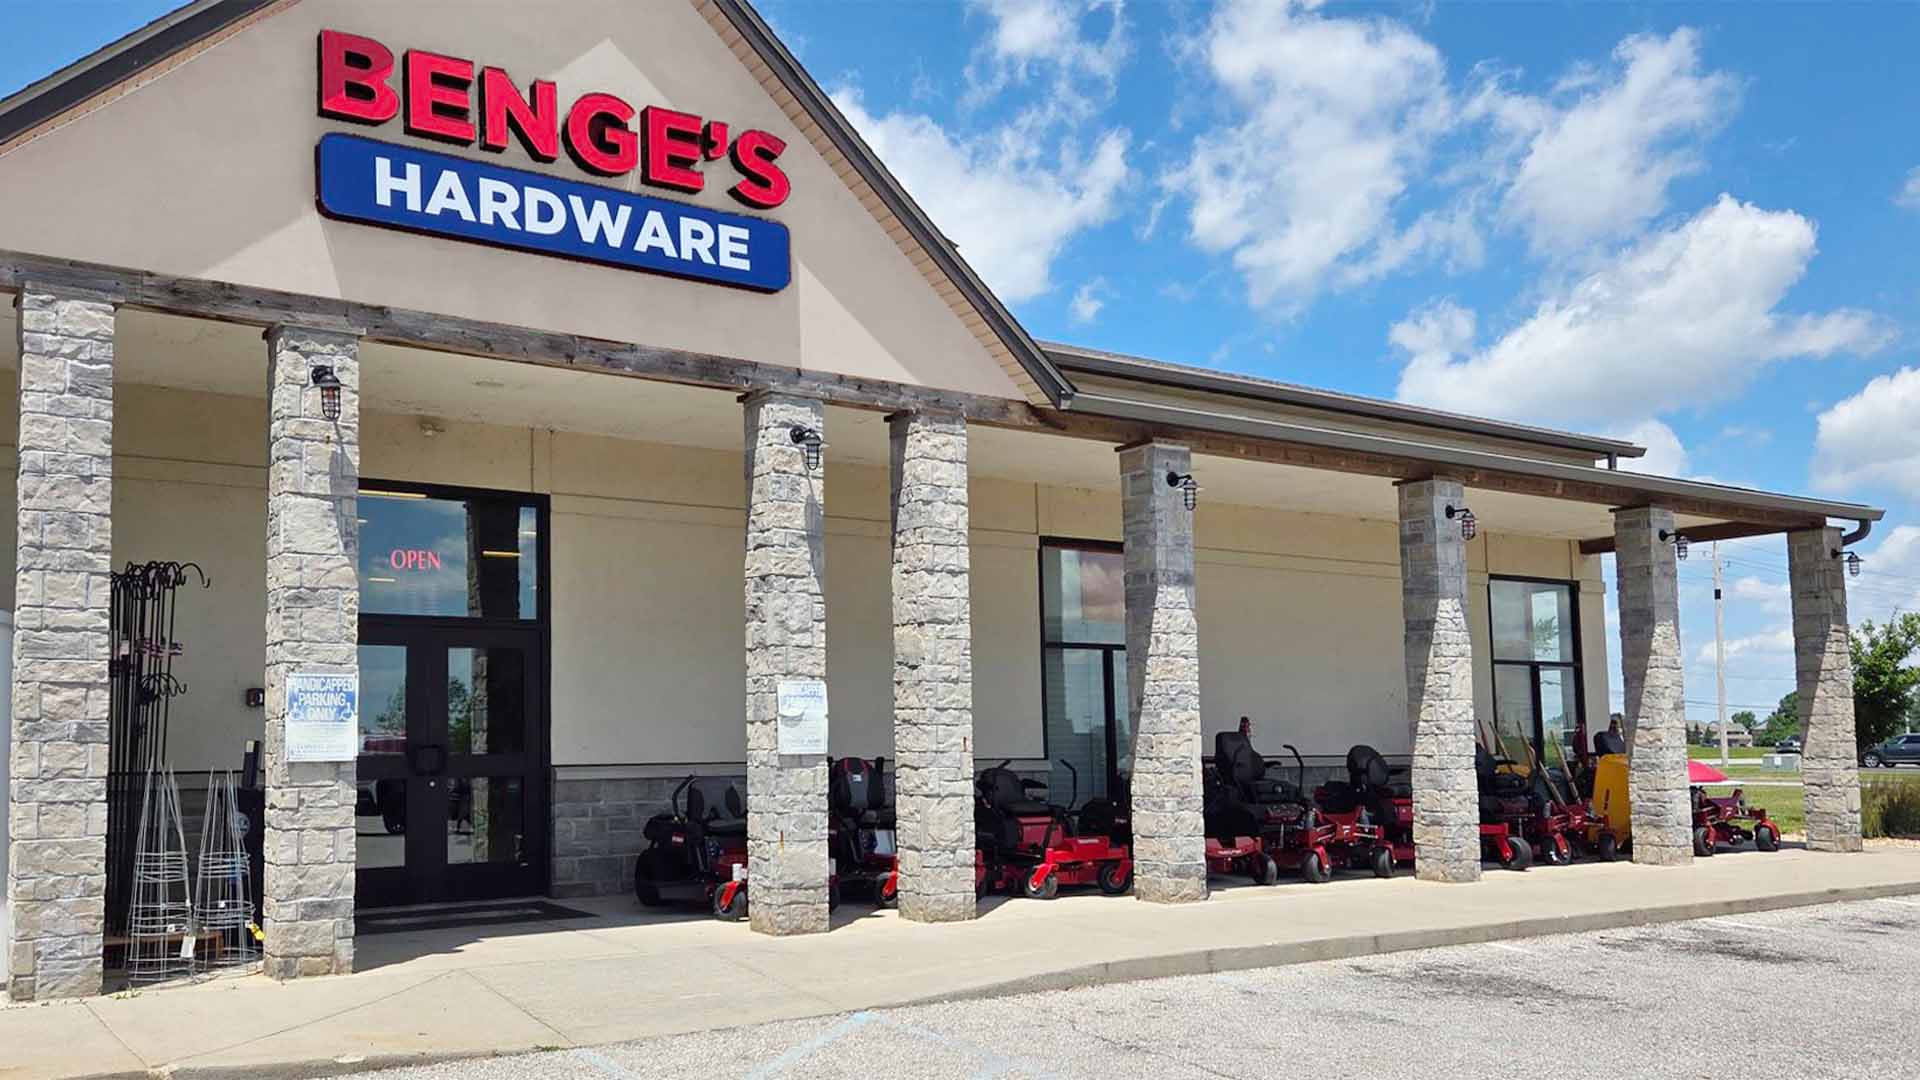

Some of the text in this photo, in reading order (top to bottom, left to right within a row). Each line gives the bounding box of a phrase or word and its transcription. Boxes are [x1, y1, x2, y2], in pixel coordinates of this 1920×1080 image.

[318, 29, 790, 209] BENGE'S
[374, 156, 751, 272] HARDWARE
[391, 550, 442, 572] OPEN
[299, 693, 346, 706] PARKING
[308, 707, 337, 720] ONLY
